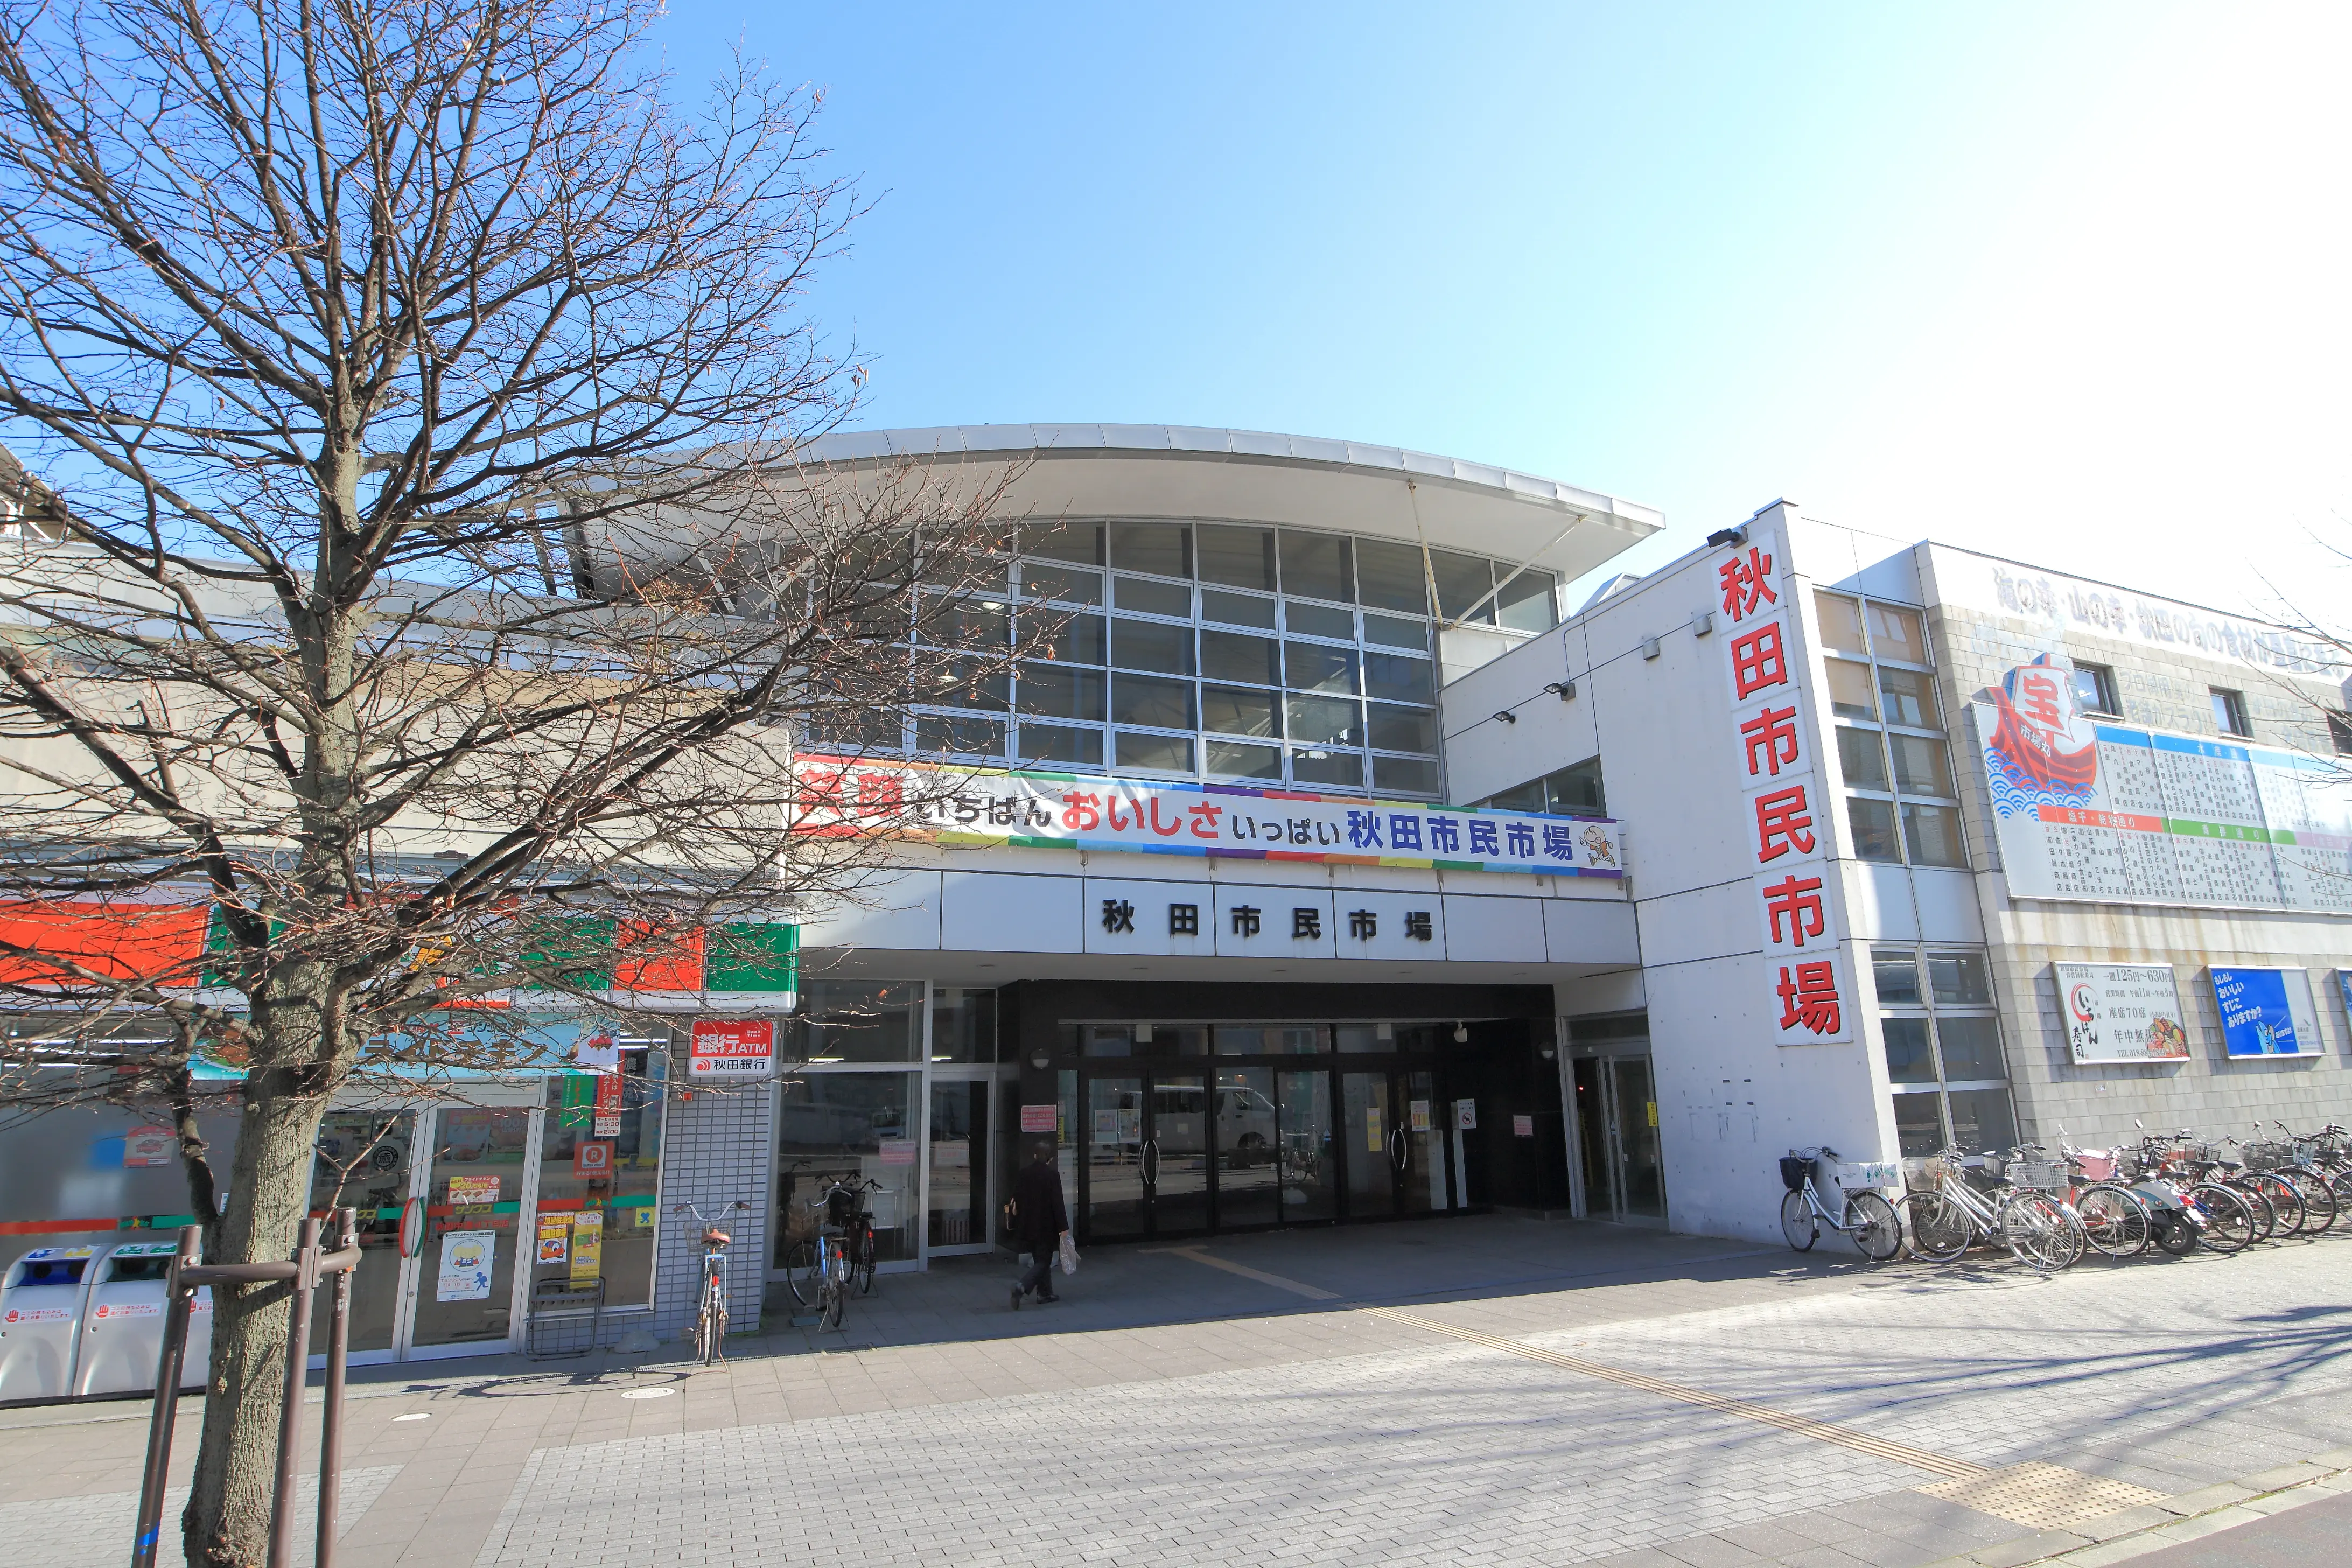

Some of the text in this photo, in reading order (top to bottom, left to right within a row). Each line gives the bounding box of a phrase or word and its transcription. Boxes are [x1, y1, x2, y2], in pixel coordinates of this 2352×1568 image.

[2023, 673, 2064, 731] 宝
[2020, 724, 2051, 757] 市場丸
[1718, 547, 1841, 1035] 秋田市民市場
[1102, 899, 1432, 941] 秋田市民市場
[2214, 972, 2232, 985] もしもし
[2105, 990, 2125, 998] 営業時間
[2218, 982, 2244, 999] おいしい
[2109, 1007, 2146, 1019] 座席70席
[2222, 997, 2243, 1013] すじこ
[2078, 990, 2098, 1044] いちばん
[2227, 1006, 2262, 1028] ありますか?
[2072, 1025, 2085, 1059] 寿司
[2114, 1028, 2154, 1044] 年中無休
[2117, 1049, 2129, 1058] TEL
[713, 1059, 766, 1070] 秋田銀行
[591, 1150, 598, 1160] R
[455, 1204, 492, 1214] サンクス
